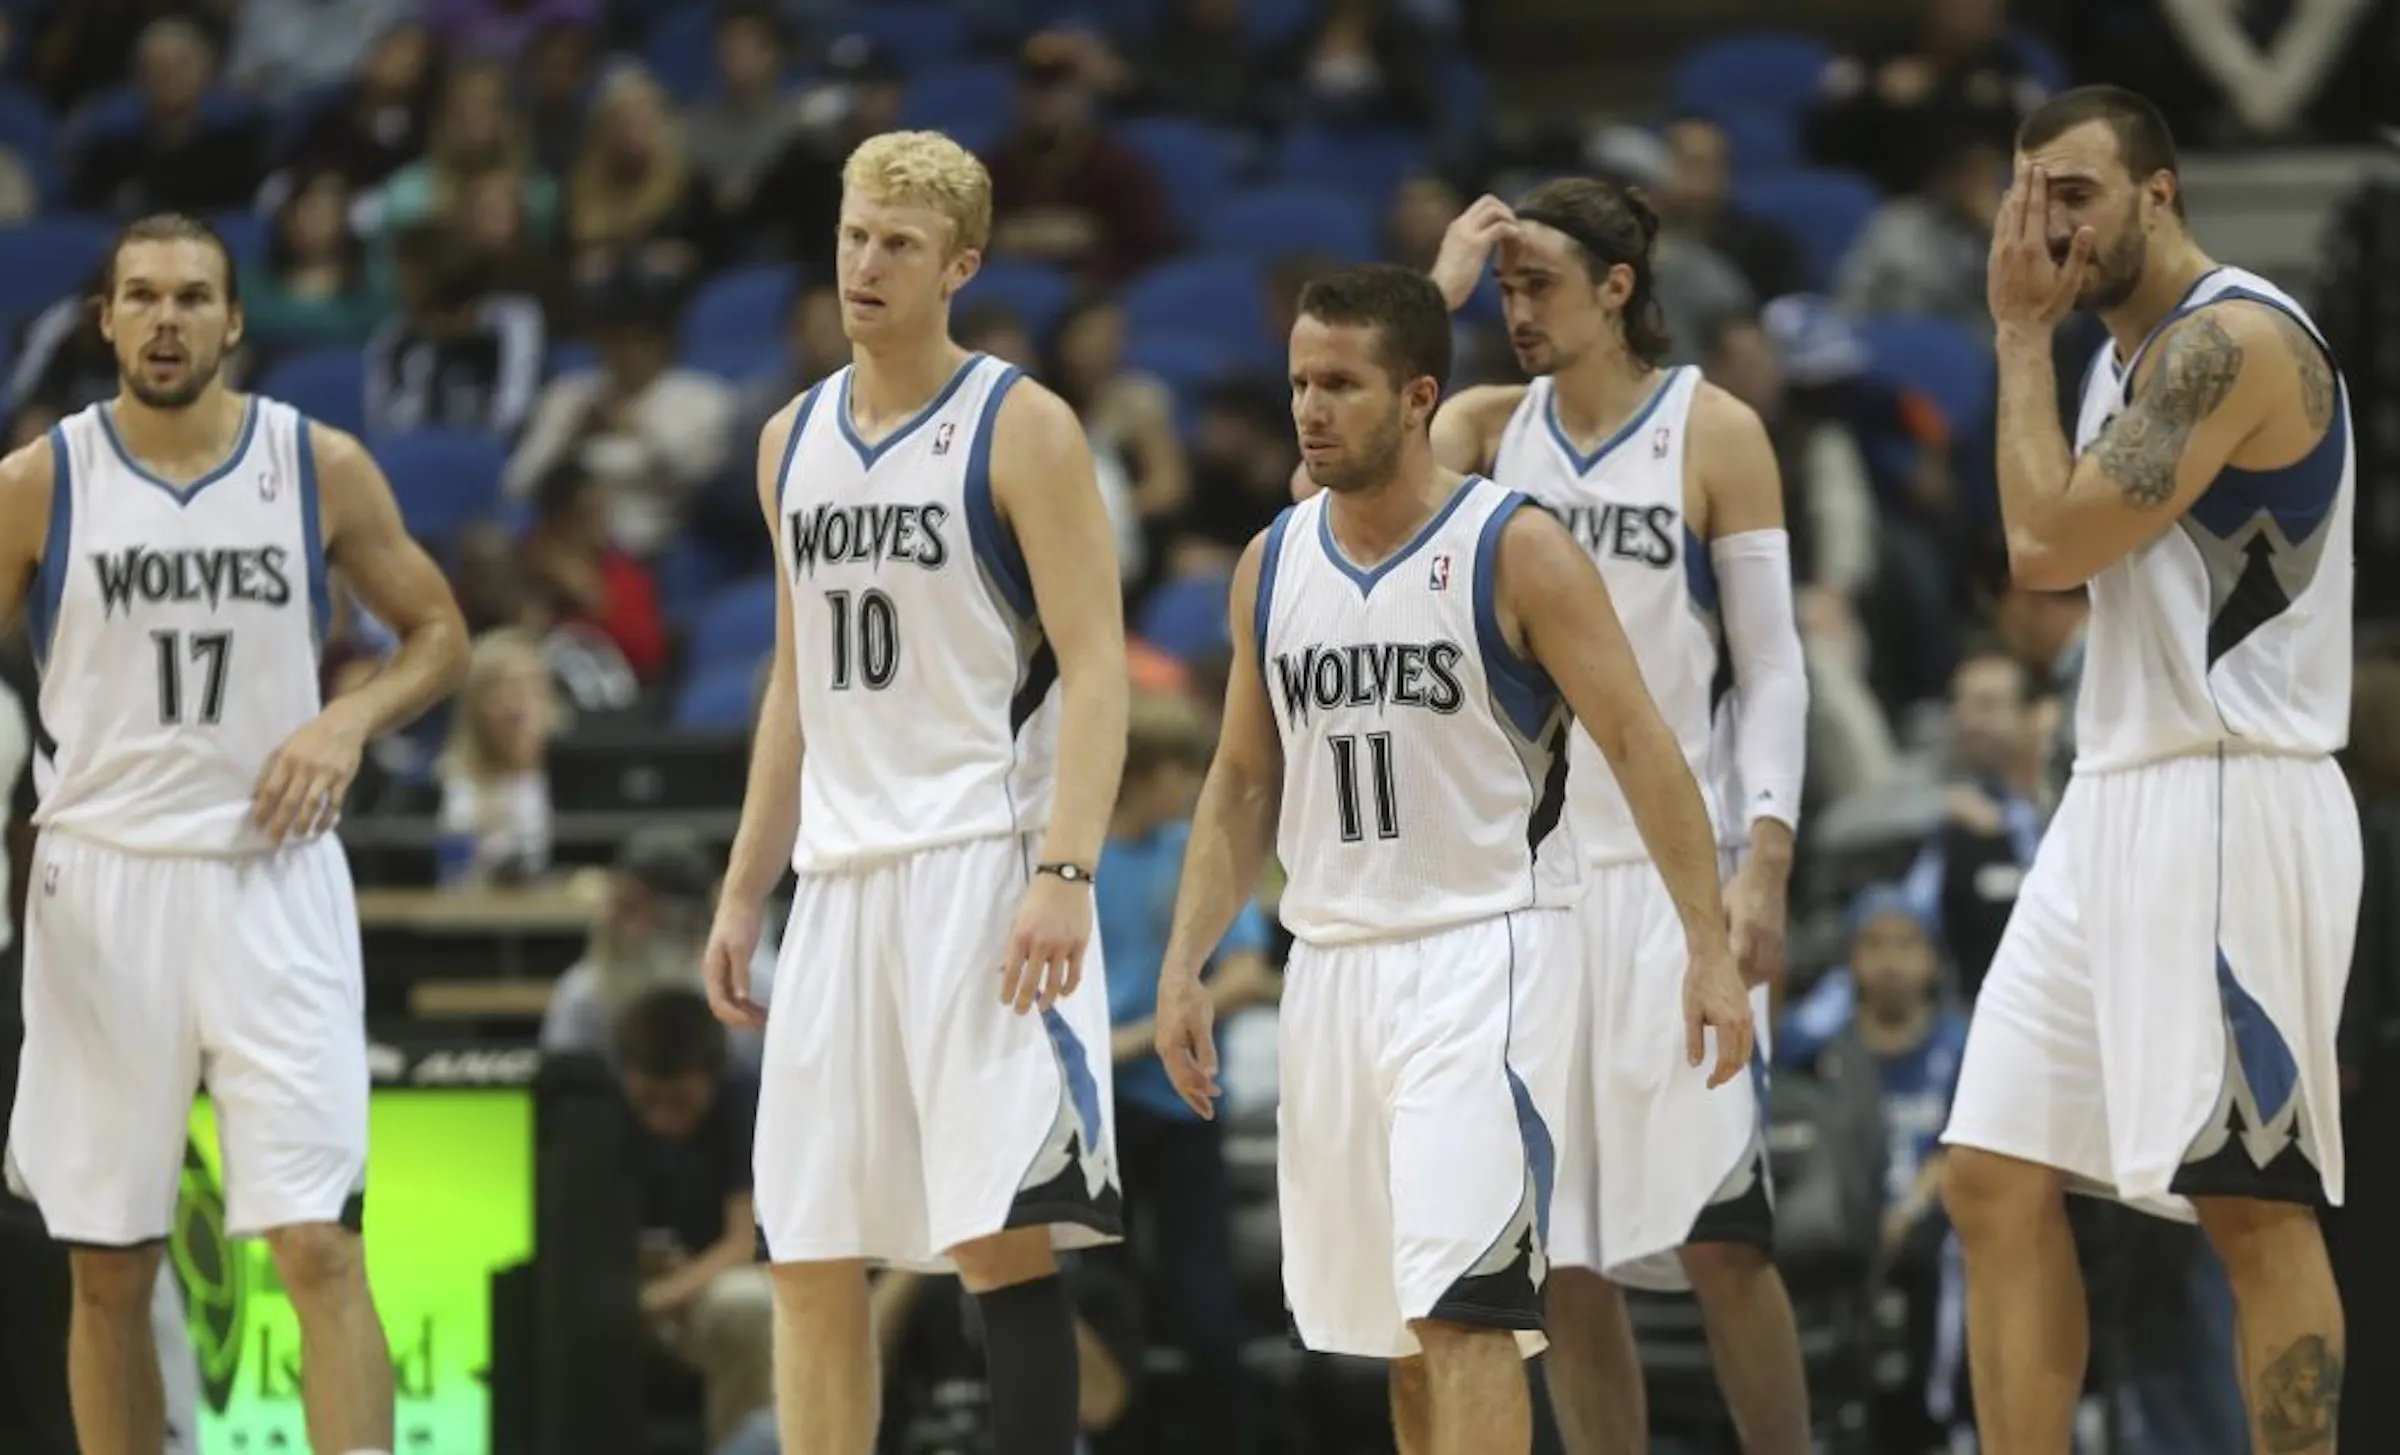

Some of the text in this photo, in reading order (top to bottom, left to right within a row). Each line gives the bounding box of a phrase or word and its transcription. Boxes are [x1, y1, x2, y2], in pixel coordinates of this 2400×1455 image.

[88, 543, 290, 623] WOLVES
[788, 501, 950, 586] WOLVES
[149, 629, 234, 726] 17
[824, 587, 900, 691] 10
[1272, 638, 1465, 733] WOLVES
[1327, 731, 1400, 842] 11
